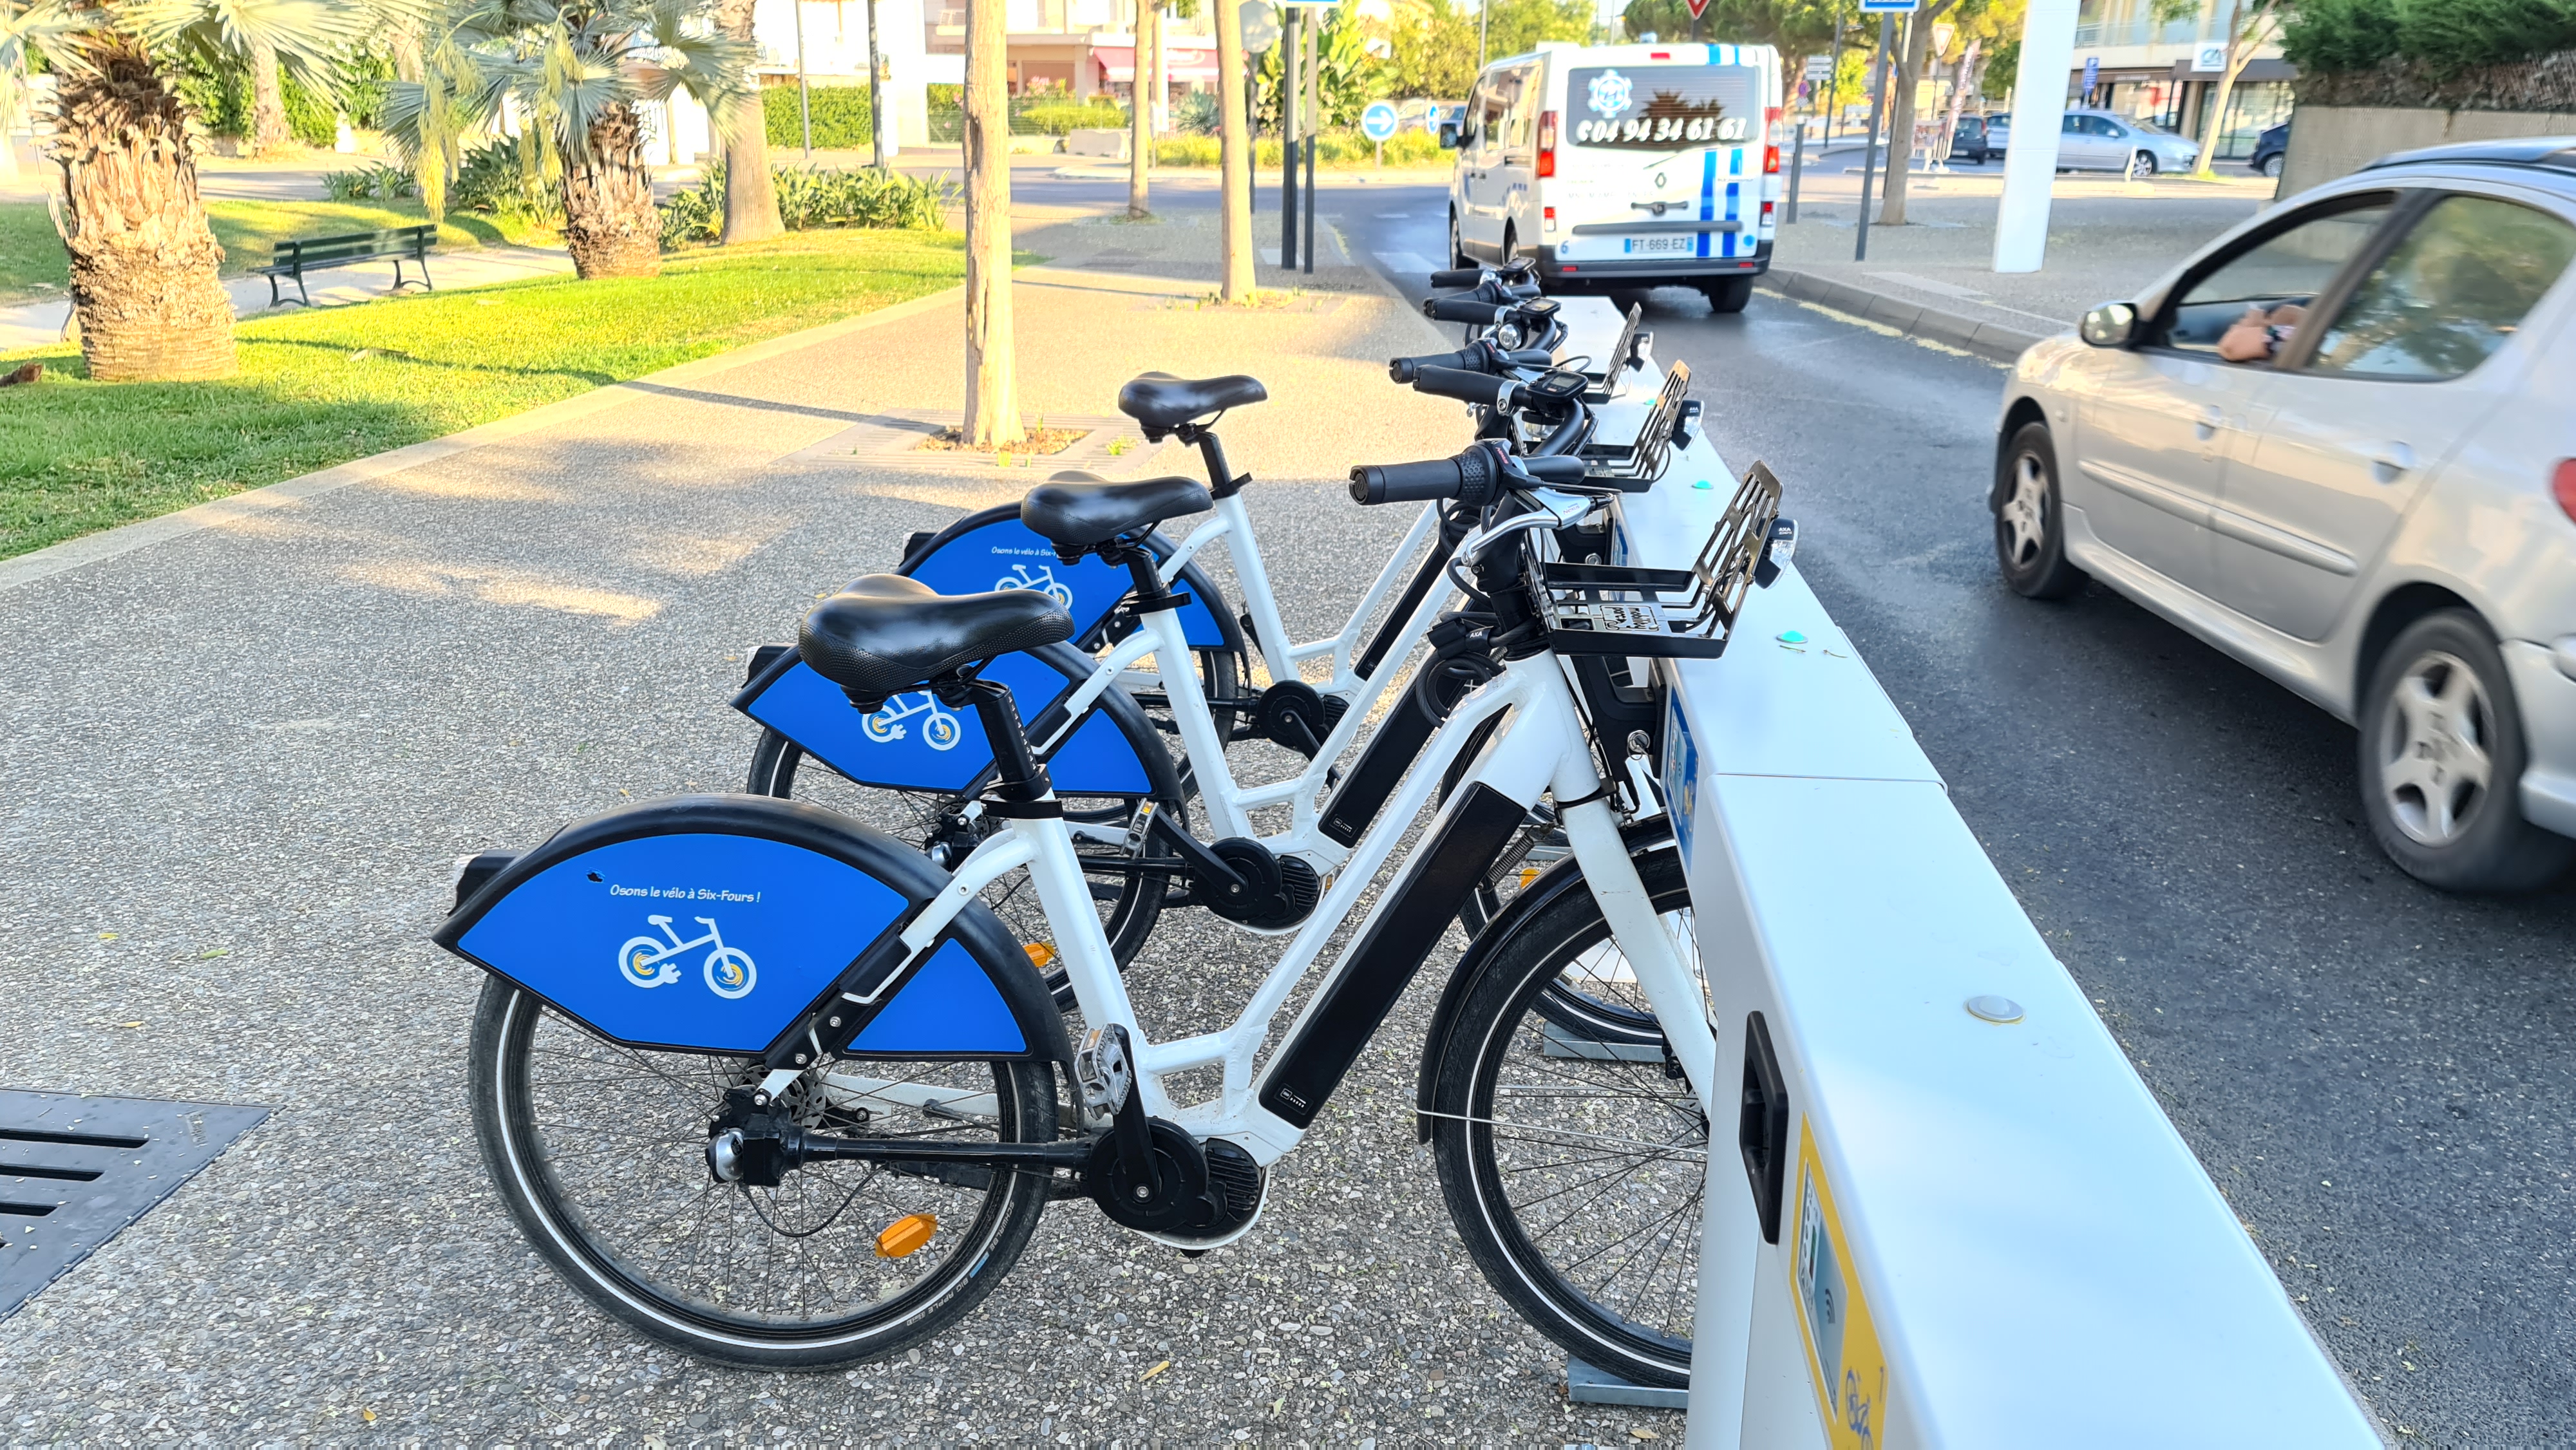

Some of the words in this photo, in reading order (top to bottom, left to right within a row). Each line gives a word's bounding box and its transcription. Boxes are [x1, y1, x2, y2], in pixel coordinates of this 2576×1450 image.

[1590, 120, 1620, 142] 04
[1622, 118, 1652, 142] 94
[1653, 117, 1684, 142] 34
[1686, 117, 1714, 141] 61
[1717, 117, 1747, 140] 61
[1561, 240, 1569, 254] 6
[1470, 630, 1482, 639] AXA
[610, 884, 648, 897] Osons
[650, 886, 660, 898] le
[662, 887, 685, 899] vélo
[687, 888, 695, 899] à
[697, 889, 754, 902] Six-Fours
[756, 891, 761, 903] !
[989, 1200, 1015, 1252] SCHWALBE
[956, 1277, 969, 1293] BIG
[927, 1292, 954, 1314] APPLE
